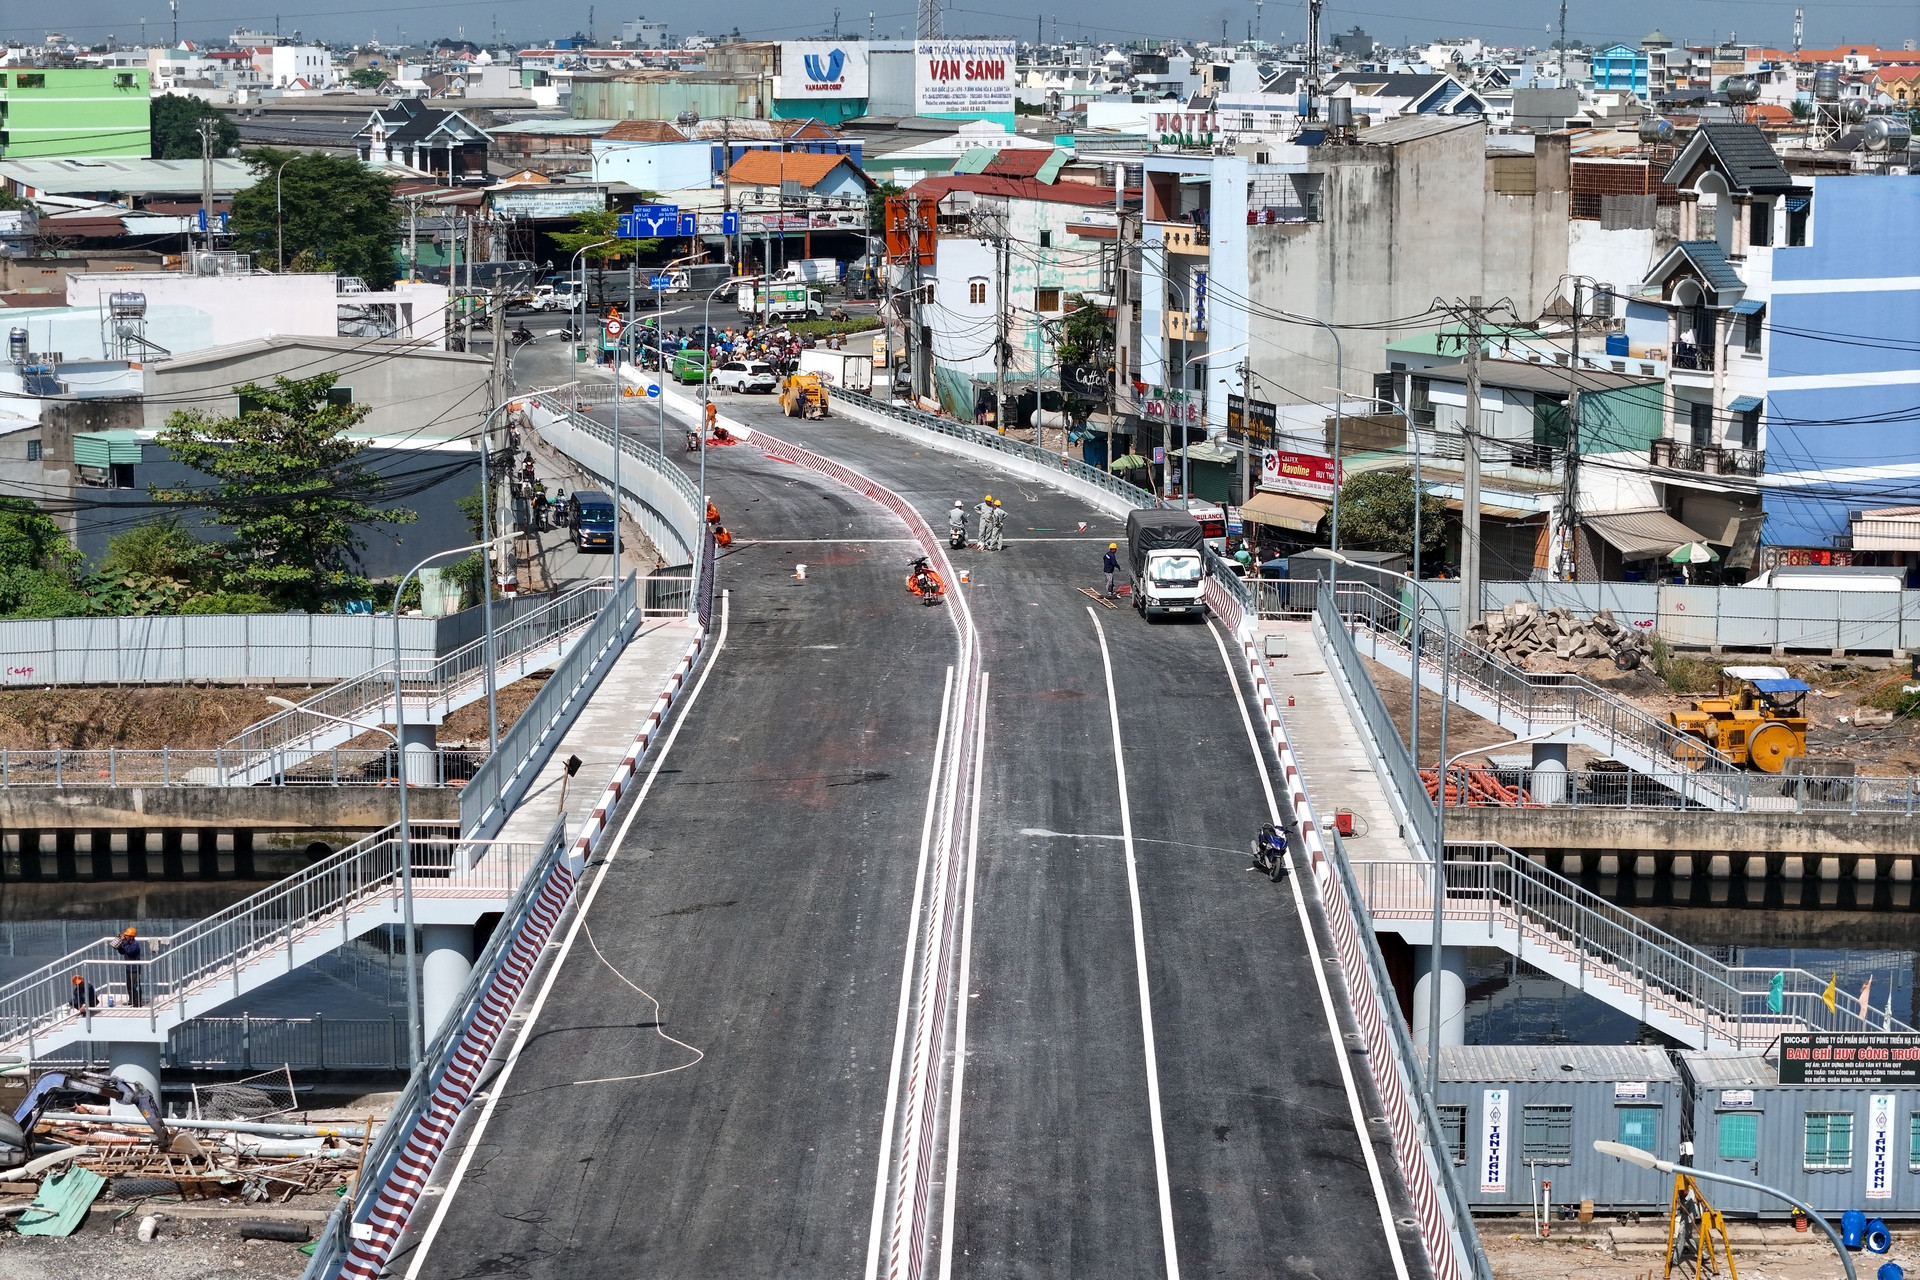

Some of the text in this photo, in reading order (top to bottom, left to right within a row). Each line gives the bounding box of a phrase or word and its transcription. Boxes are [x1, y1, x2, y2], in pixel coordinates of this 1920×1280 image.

[929, 60, 1005, 84] VẠN SANH
[1156, 113, 1220, 132] HOTEL
[1196, 273, 1206, 331] HOTEL
[1282, 462, 1310, 476] Havoline
[1816, 1035, 1829, 1044] CÔNG
[1877, 1036, 1889, 1044] PHÁT
[1904, 1037, 1911, 1046] HẠ
[1787, 1048, 1810, 1060] BAN
[1812, 1045, 1832, 1060] CHỈ
[1834, 1048, 1856, 1060] HUY
[1858, 1046, 1889, 1060] CÔNG
